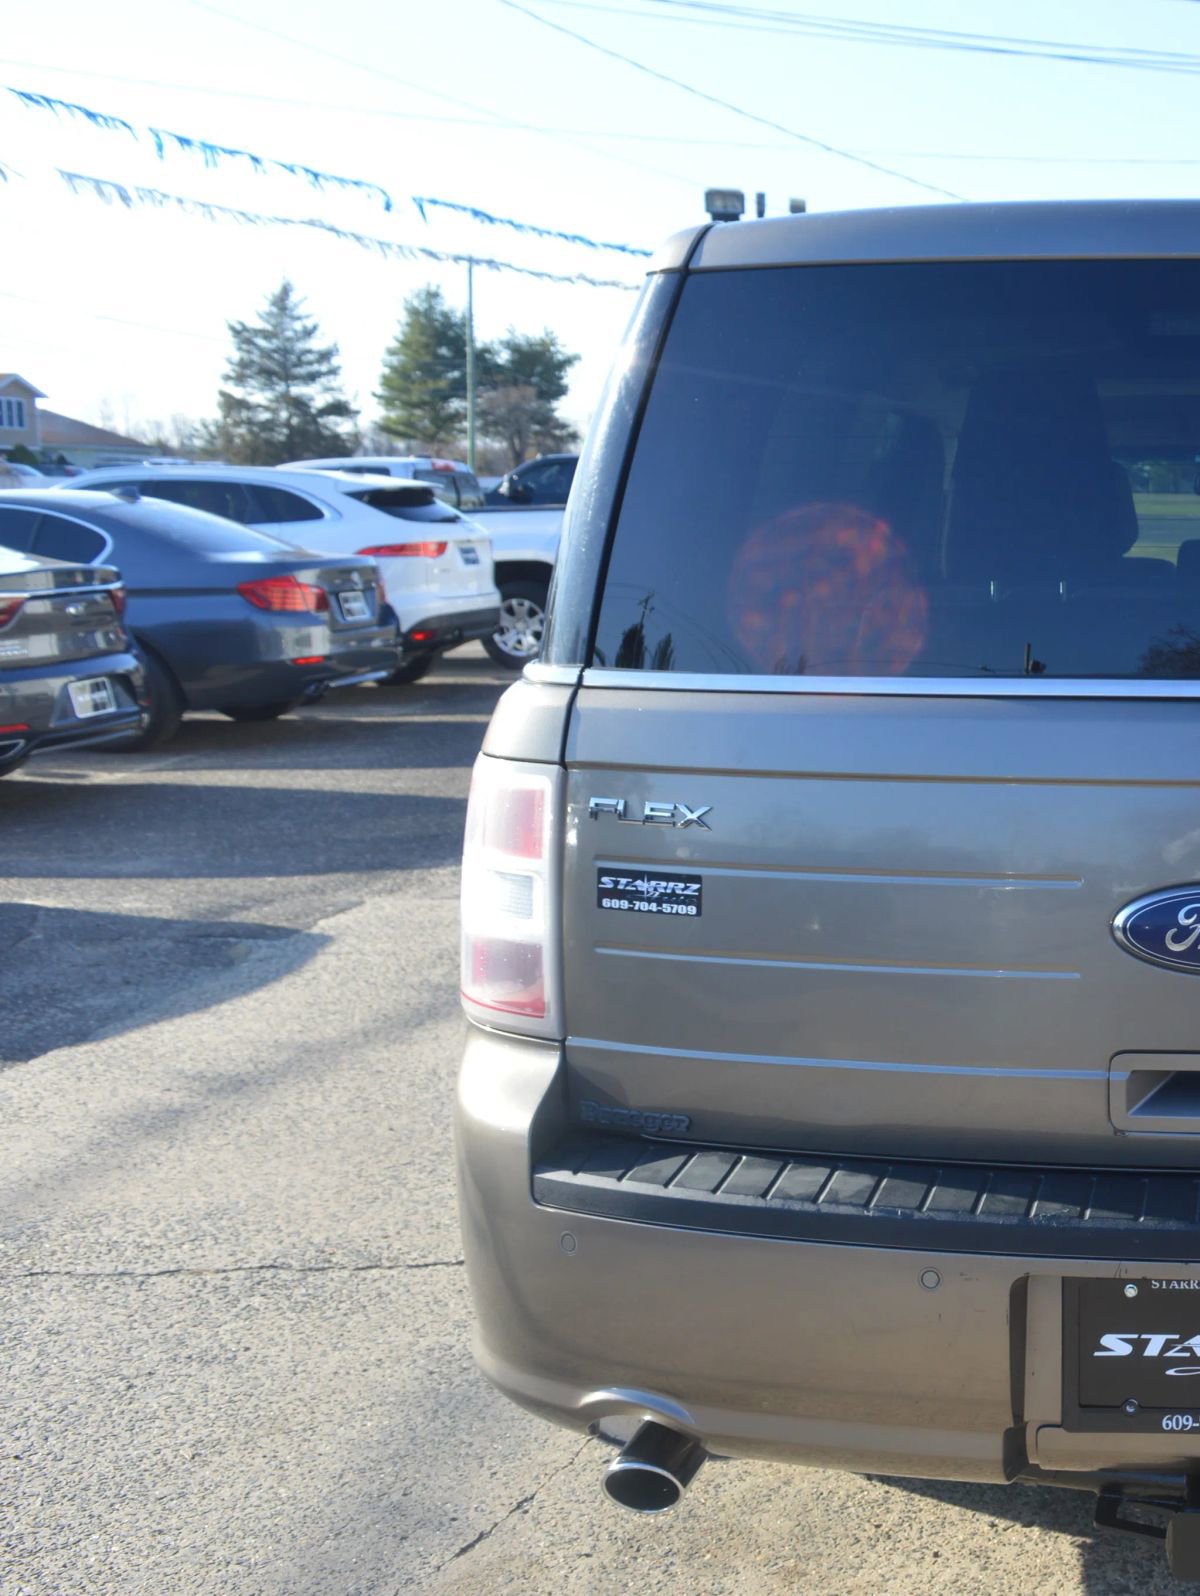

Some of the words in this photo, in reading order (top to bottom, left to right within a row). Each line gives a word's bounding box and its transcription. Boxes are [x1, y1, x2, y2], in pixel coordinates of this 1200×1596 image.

[589, 797, 713, 831] FLEX
[598, 875, 702, 896] STARRZ
[601, 897, 698, 916] 609-704-5709
